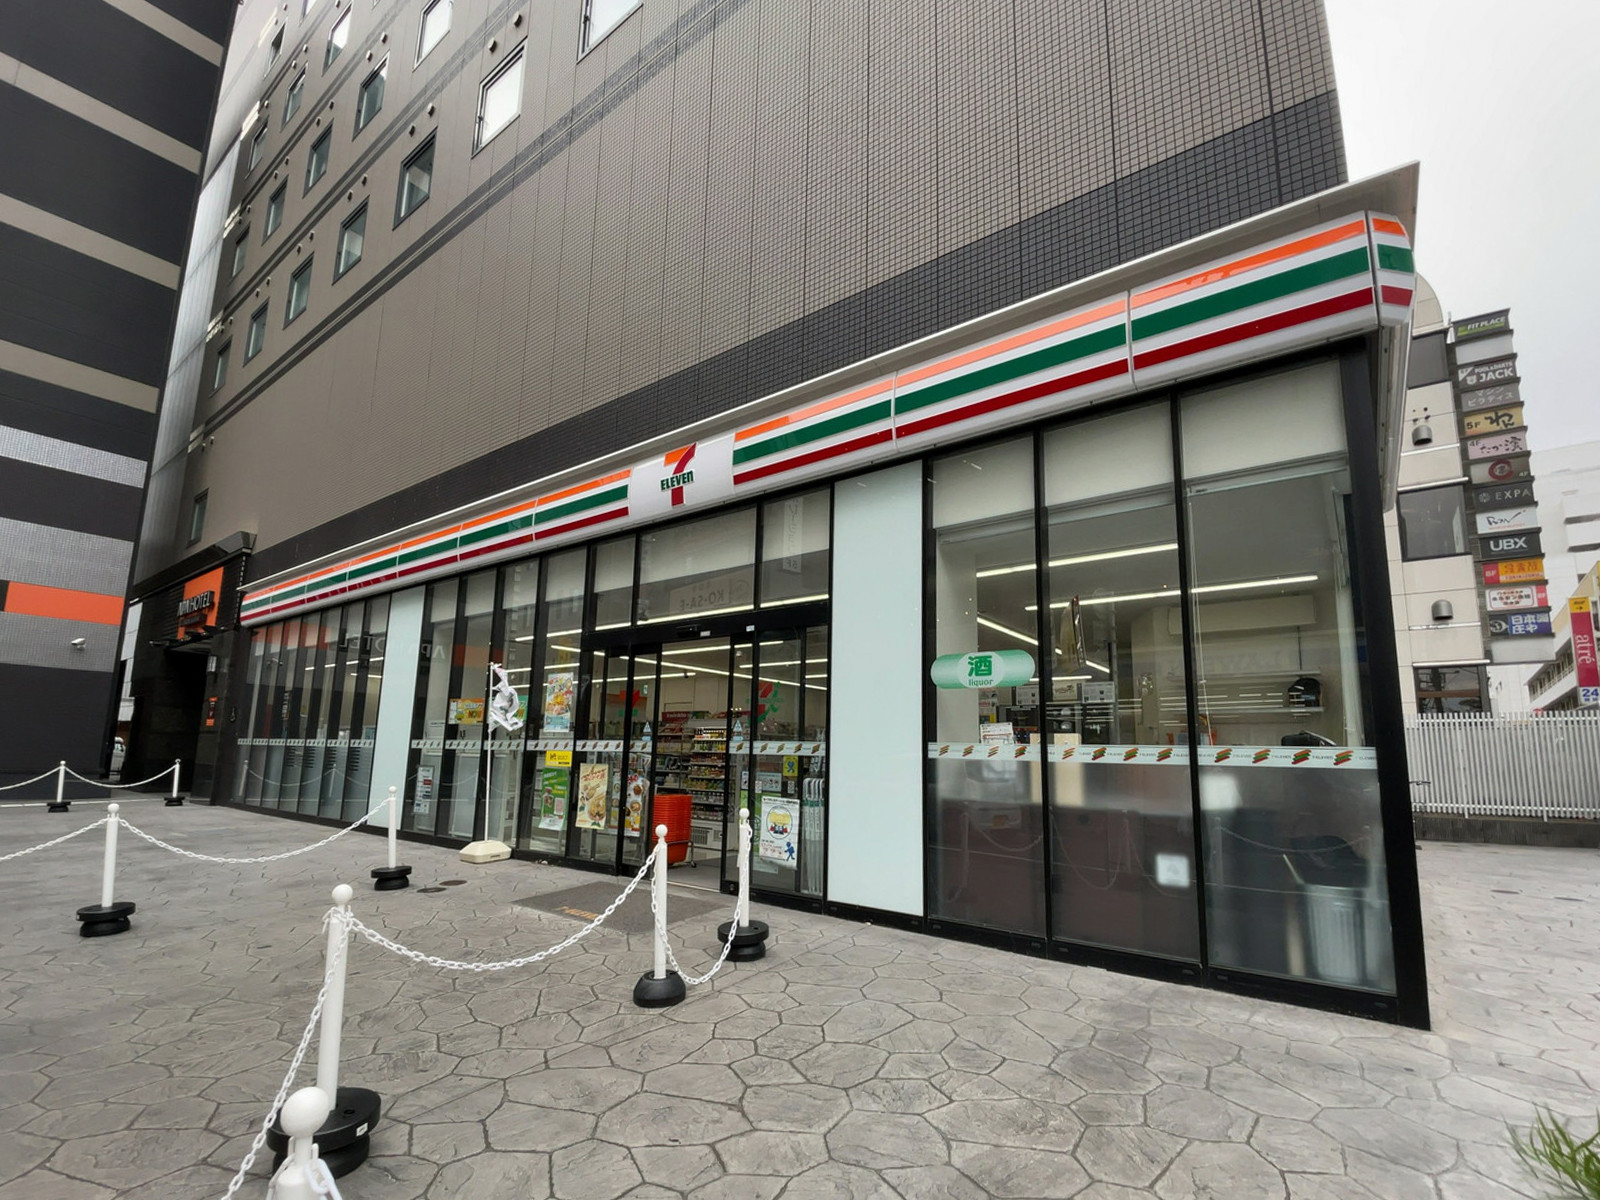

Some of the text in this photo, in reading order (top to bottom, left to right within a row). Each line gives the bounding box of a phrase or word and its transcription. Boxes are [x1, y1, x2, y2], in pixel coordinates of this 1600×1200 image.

[1479, 367, 1514, 382] JACK
[1466, 421, 1480, 430] 5F
[1495, 488, 1532, 500] EXPA
[1490, 537, 1528, 551] UBX
[1574, 634, 1596, 664] atré
[968, 655, 993, 677] 酒
[968, 678, 994, 687] liquor
[1582, 688, 1599, 697] 24
